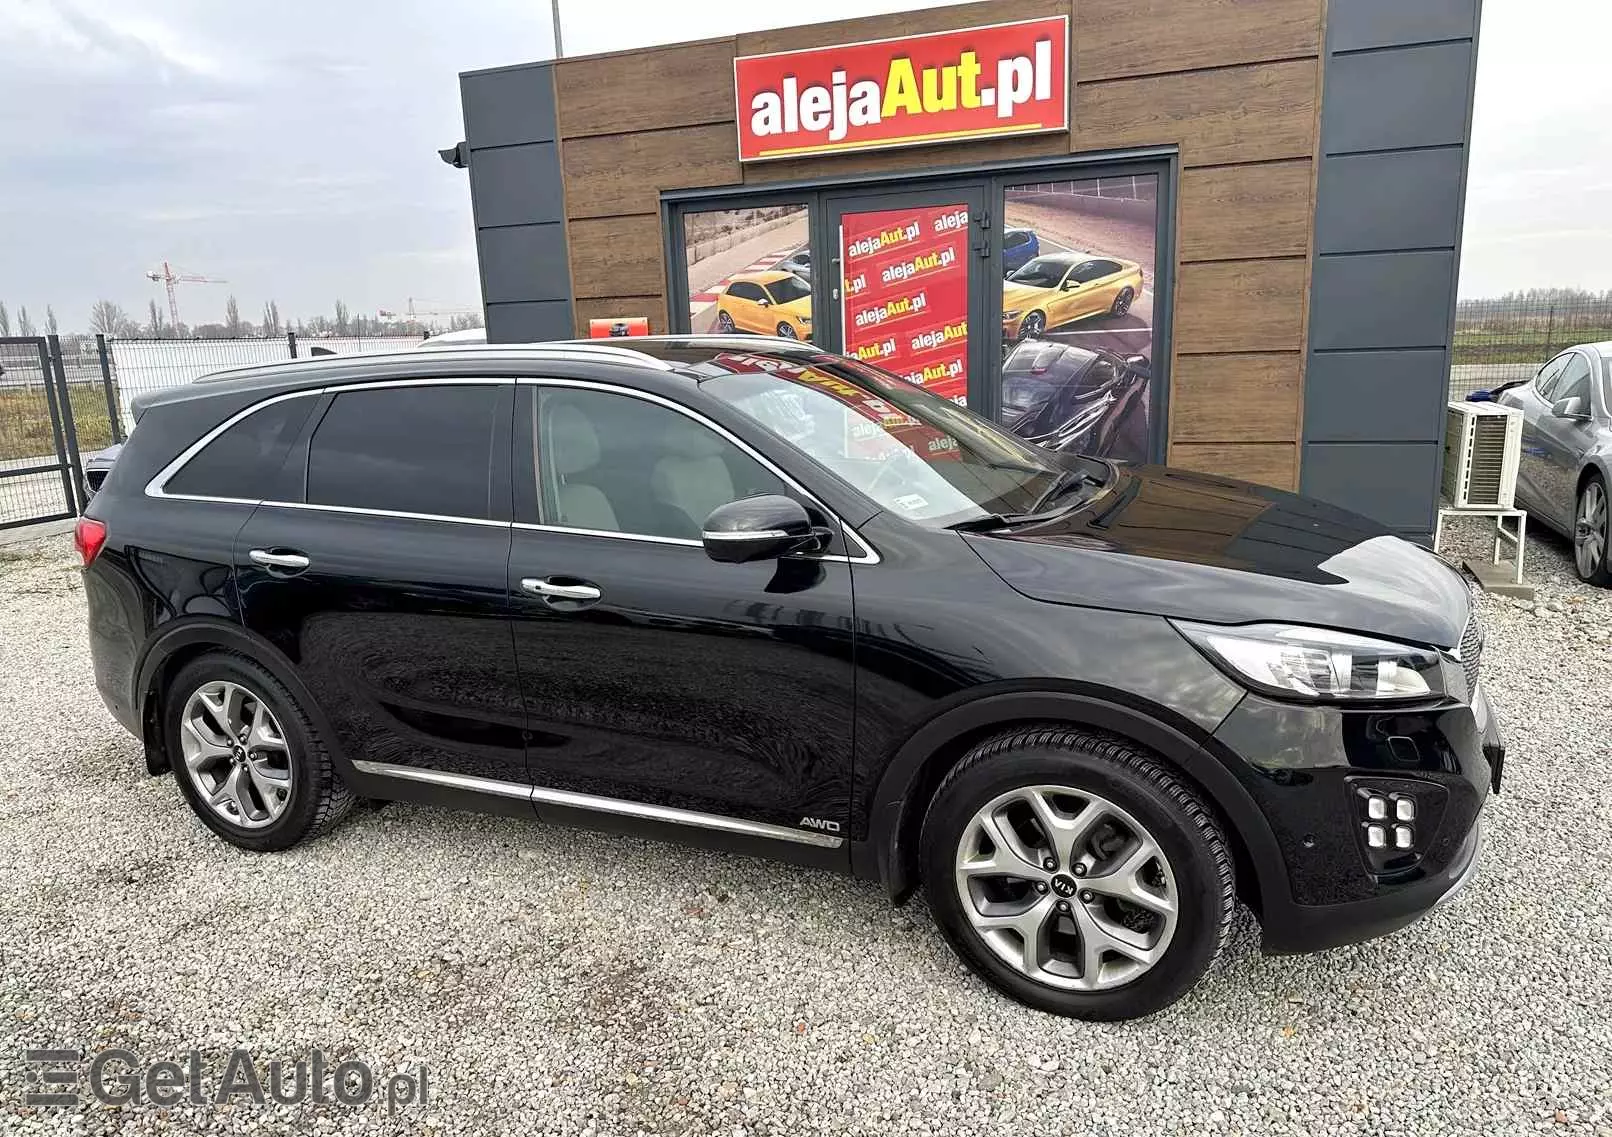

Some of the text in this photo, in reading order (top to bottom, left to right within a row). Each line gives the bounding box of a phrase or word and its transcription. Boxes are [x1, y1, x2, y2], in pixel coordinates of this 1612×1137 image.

[751, 40, 1051, 141] alejaAut.pl
[848, 221, 920, 257] alejaAut.pl
[881, 247, 955, 282] alejaAut.pl
[855, 293, 927, 326] alejaAut.pl
[800, 817, 840, 832] AWD
